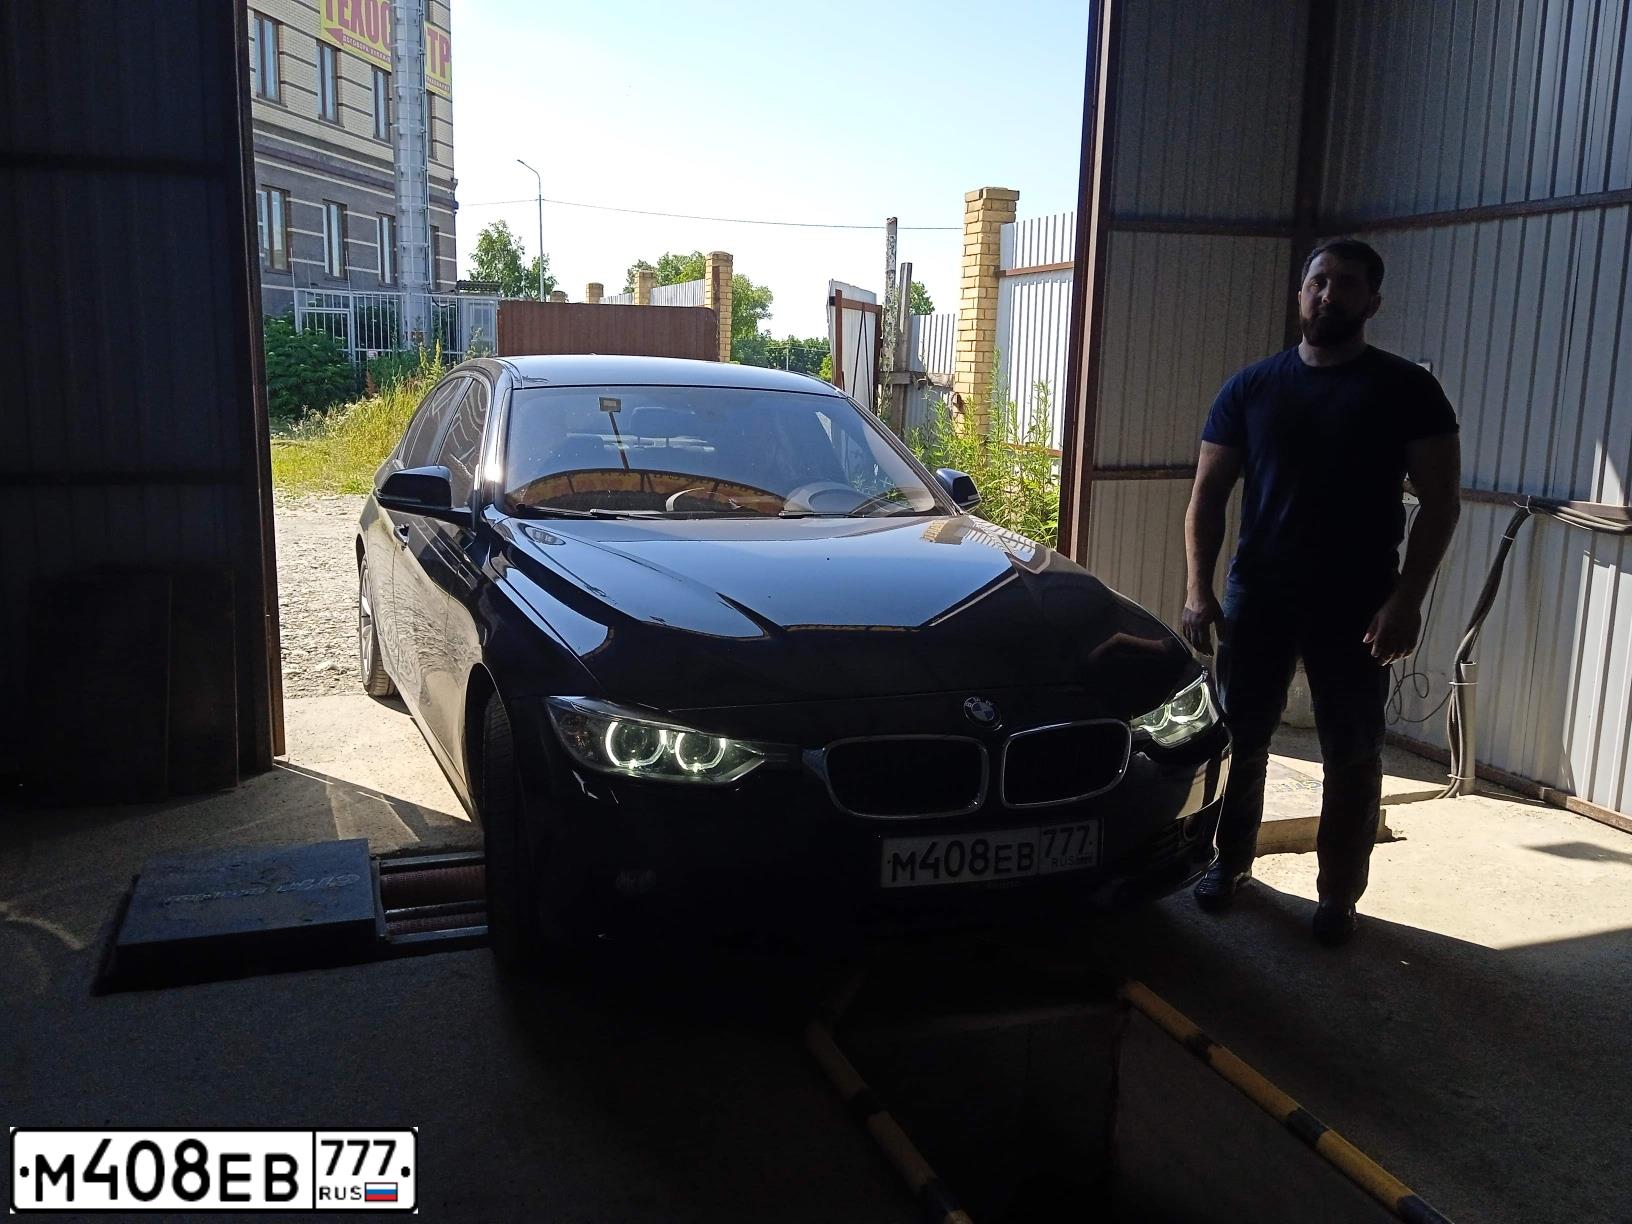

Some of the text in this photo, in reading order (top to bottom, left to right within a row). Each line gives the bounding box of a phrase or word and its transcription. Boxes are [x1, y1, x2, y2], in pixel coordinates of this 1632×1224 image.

[891, 825, 1090, 882] М408ЕВ 777
[1050, 855, 1074, 868] RUS
